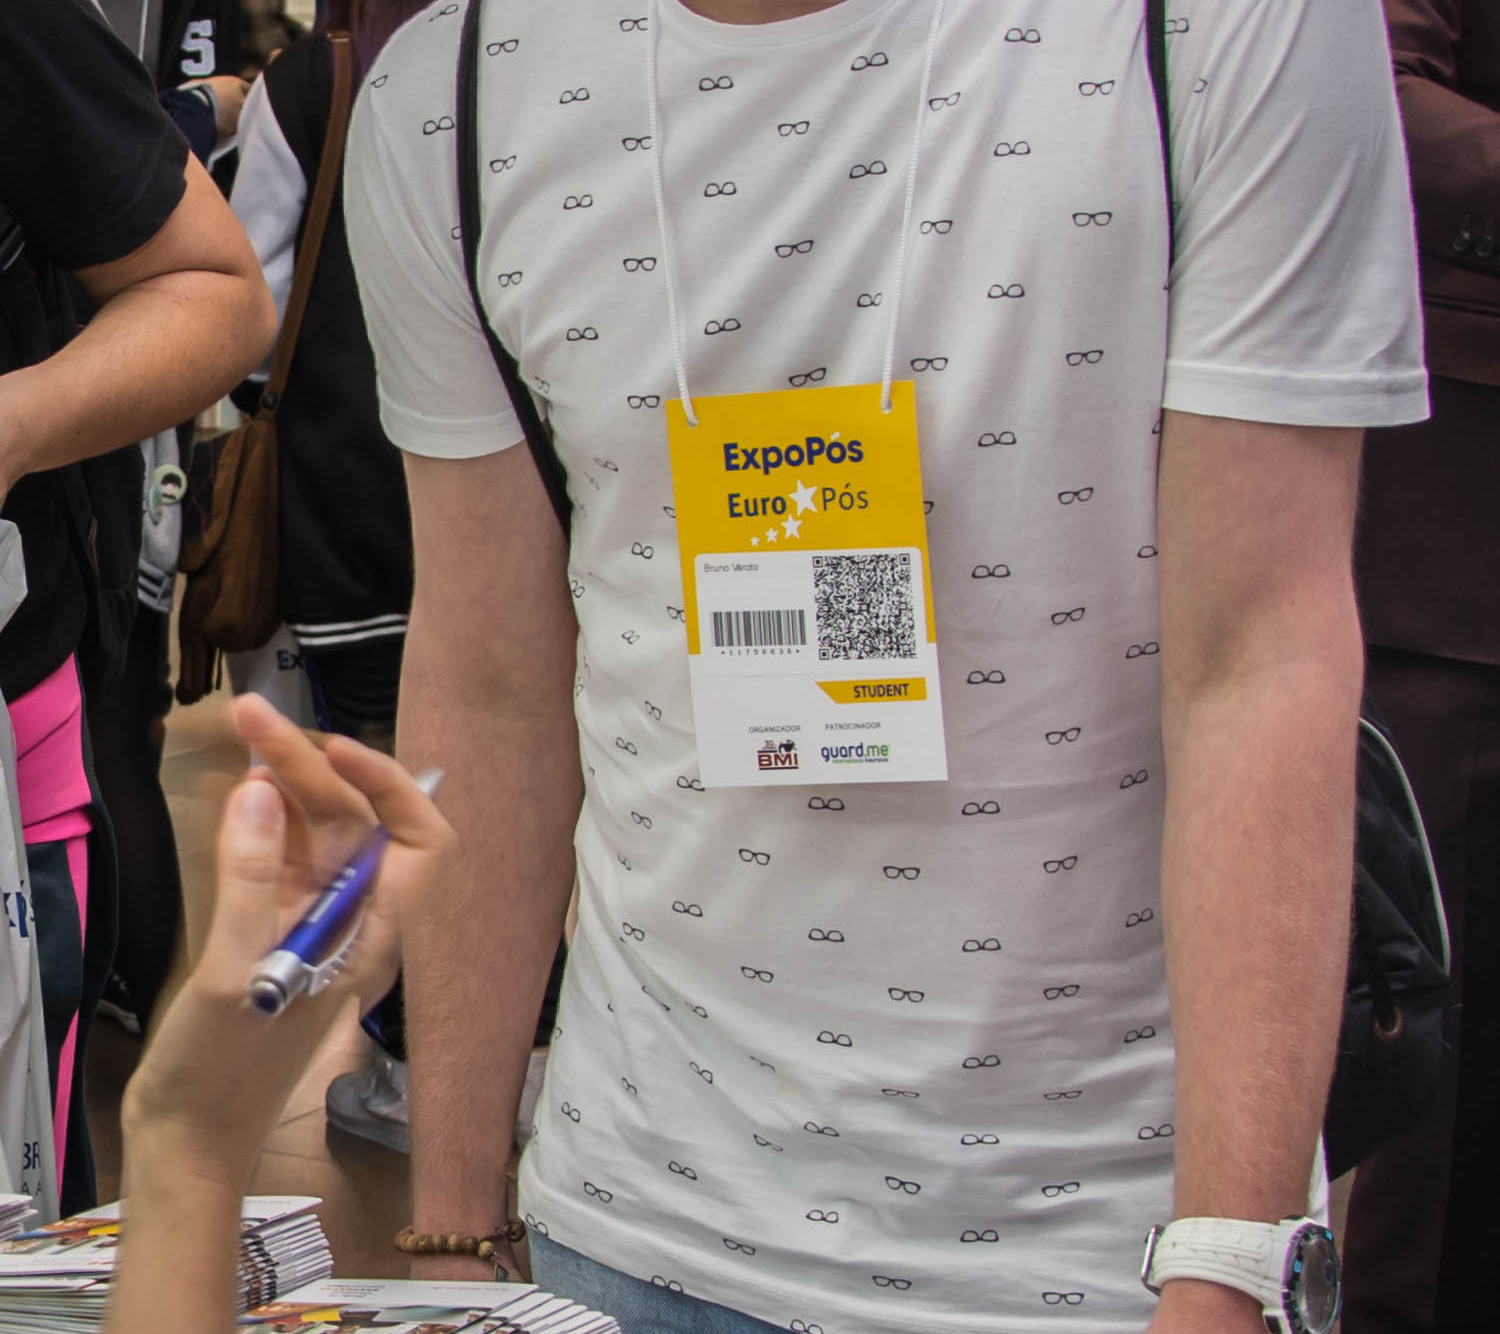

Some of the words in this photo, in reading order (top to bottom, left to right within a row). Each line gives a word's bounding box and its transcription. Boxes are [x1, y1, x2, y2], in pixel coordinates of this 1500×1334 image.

[723, 431, 864, 476] ExpoPós
[728, 492, 786, 518] Euro
[822, 482, 869, 511] Pós
[853, 683, 909, 698] STUDENT
[749, 724, 801, 734] ORGANIZADOR
[825, 721, 881, 731] PATROCINADOR
[757, 753, 798, 767] BMI
[821, 742, 889, 763] guard.me
